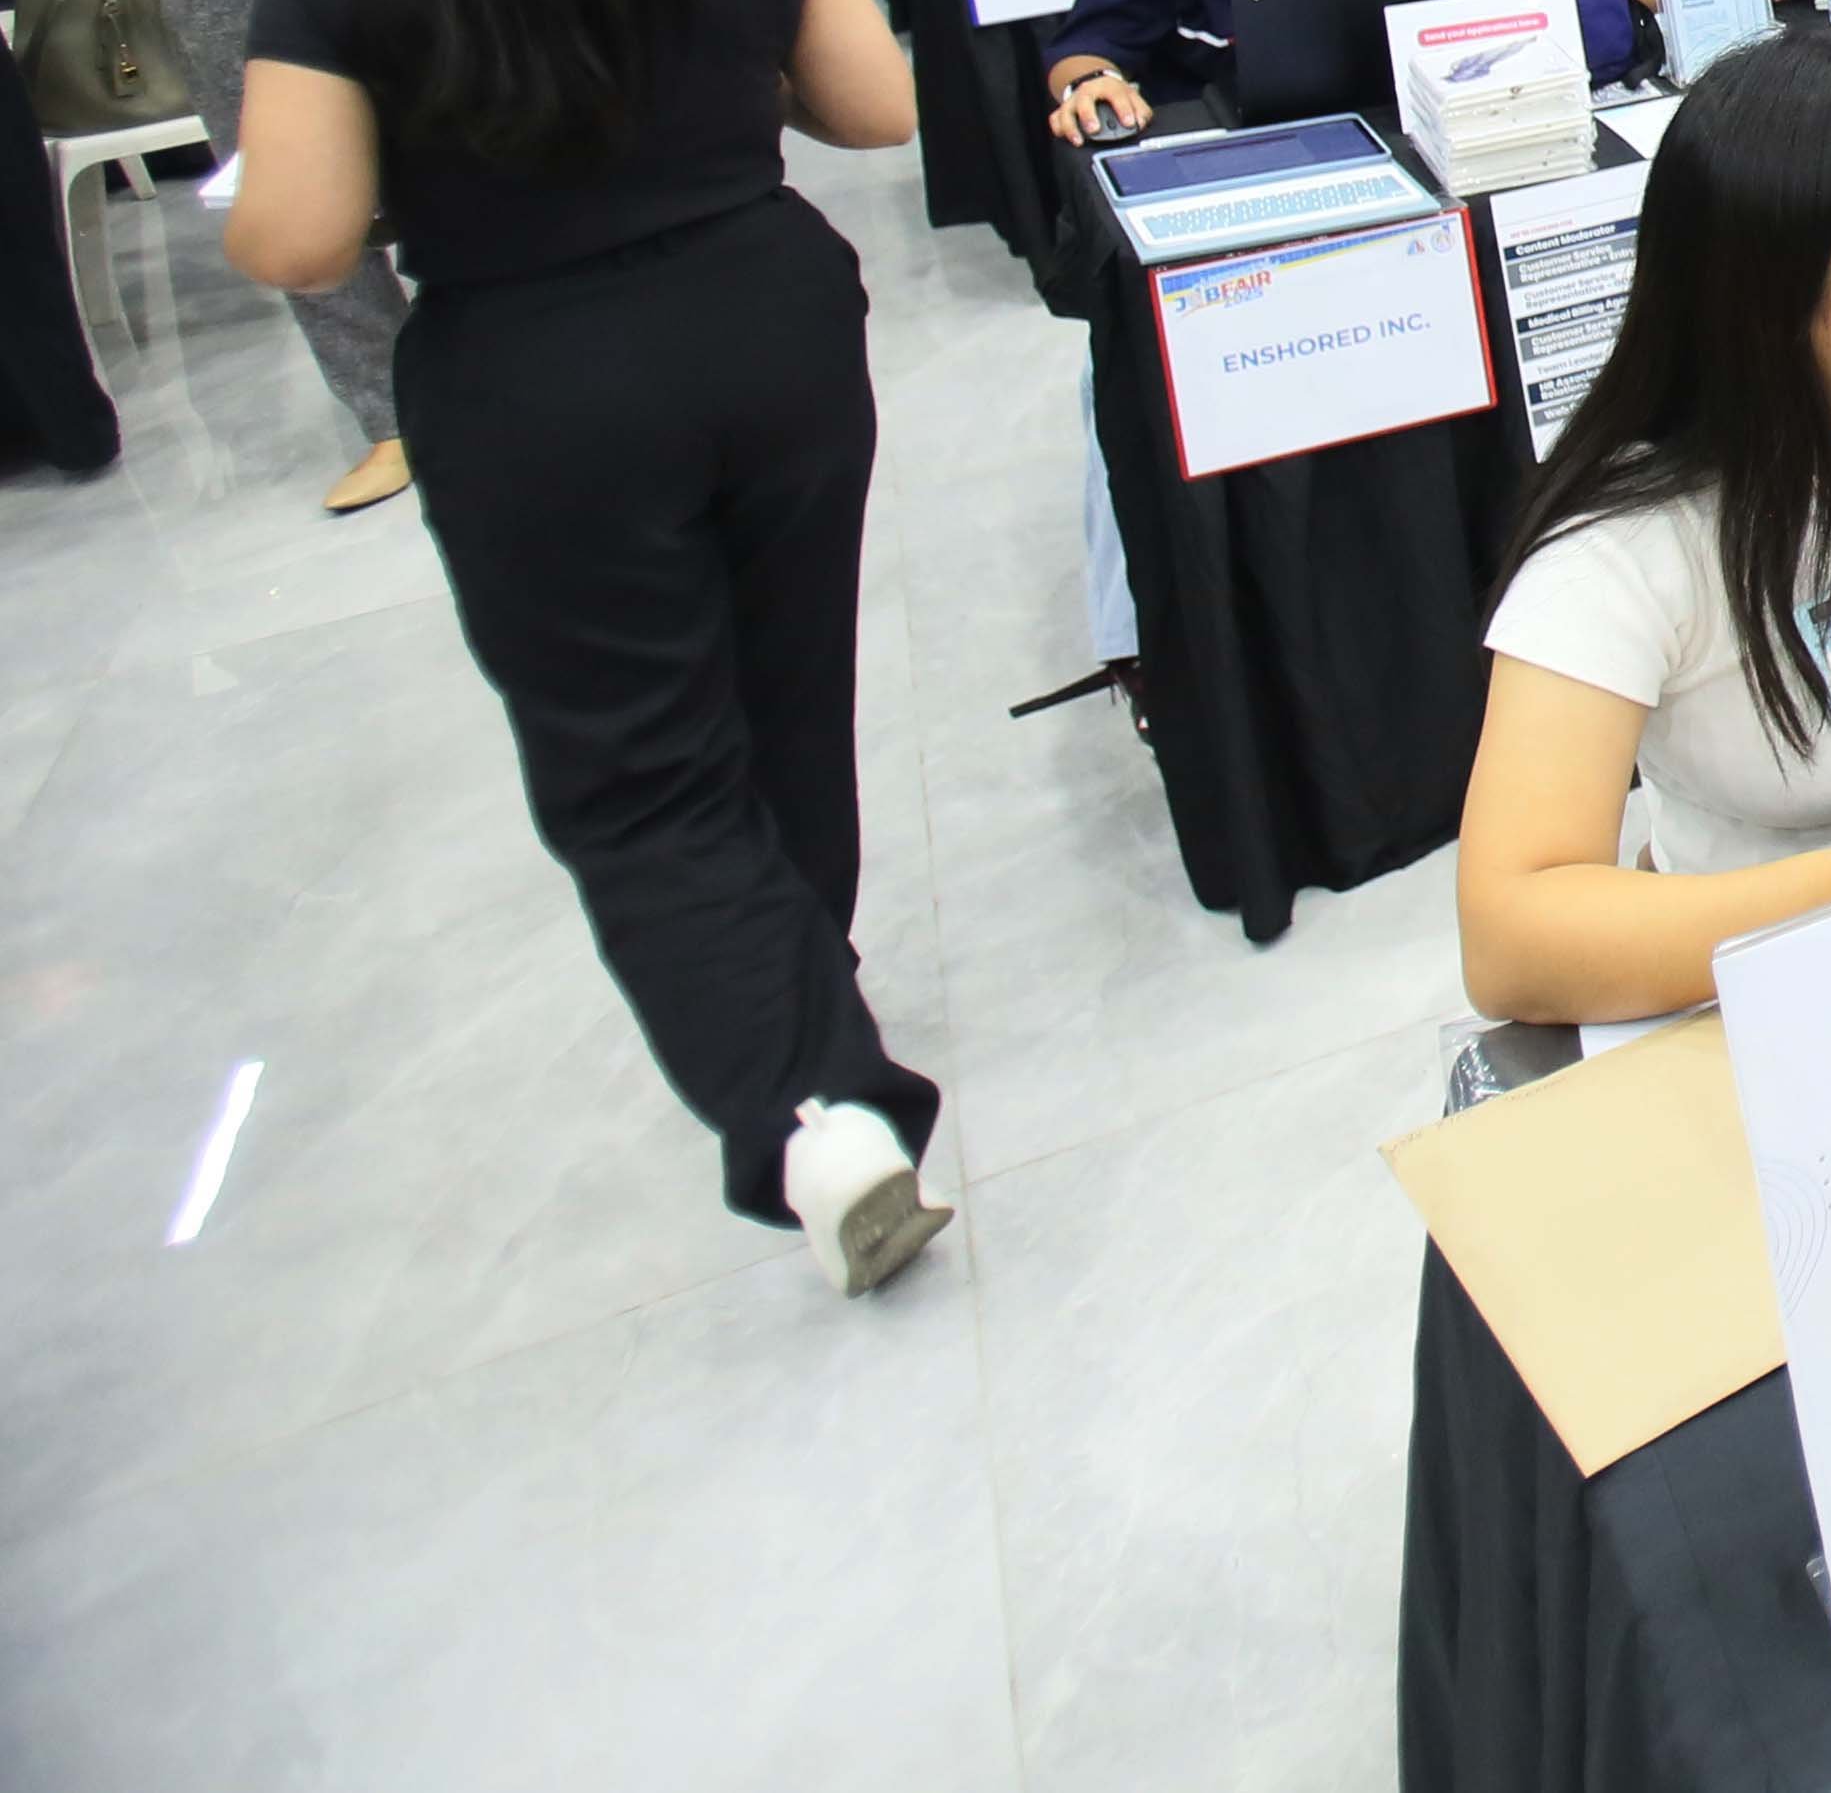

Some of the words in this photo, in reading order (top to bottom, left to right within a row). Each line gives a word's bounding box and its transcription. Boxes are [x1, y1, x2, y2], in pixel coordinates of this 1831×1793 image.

[1515, 237, 1561, 256] Content
[1560, 224, 1616, 246] Moderator
[1519, 251, 1573, 273] Customer
[1223, 324, 1372, 374] ENSHORED
[1379, 312, 1432, 339] INC.
